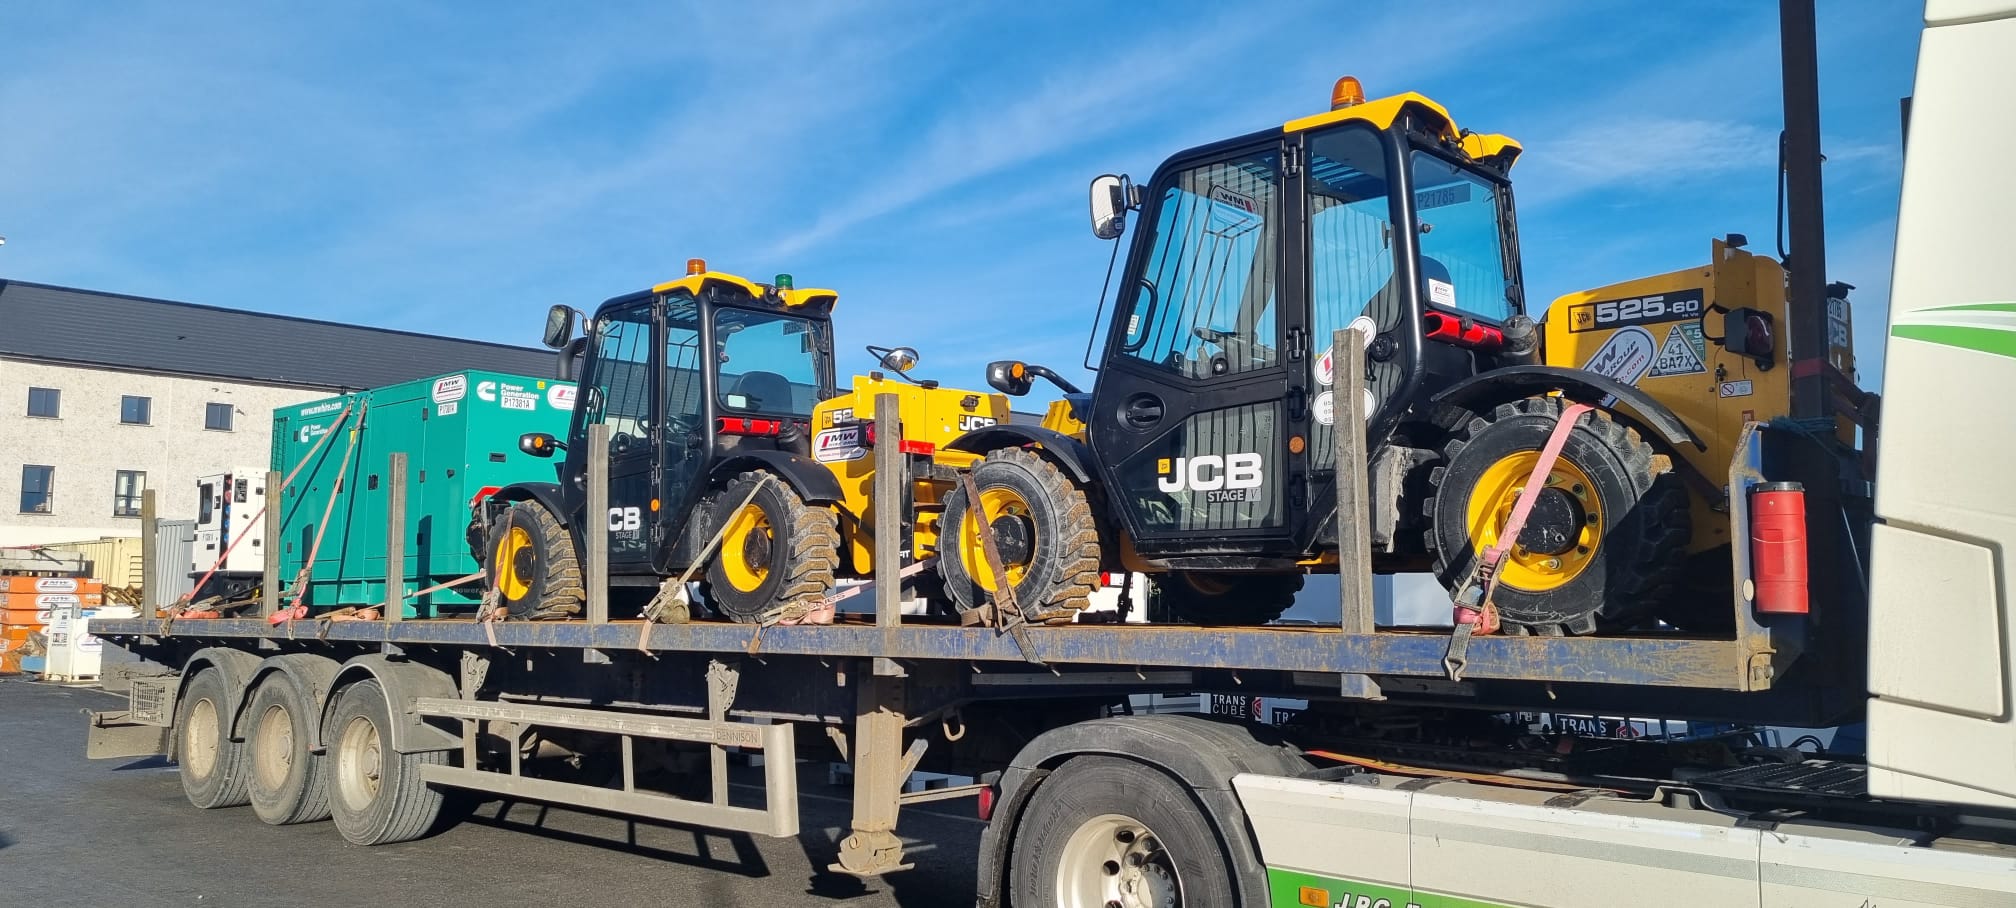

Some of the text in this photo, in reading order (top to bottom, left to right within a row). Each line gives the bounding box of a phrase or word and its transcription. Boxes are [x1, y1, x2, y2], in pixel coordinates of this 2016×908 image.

[1597, 296, 1699, 323] 525-60
[1668, 343, 1683, 355] 41
[1660, 355, 1693, 370] BA7X
[501, 390, 540, 400] Generation
[504, 399, 530, 409] P17381A
[831, 432, 857, 442] MW
[1158, 453, 1263, 493] JCB
[1207, 490, 1245, 503] STAGE
[607, 507, 641, 532] CB
[615, 531, 633, 540] STAGE
[1213, 694, 1246, 706] TRANS
[1212, 703, 1246, 716] CUBE
[1560, 718, 1607, 733] TRANS
[716, 730, 758, 743] DENNISON
